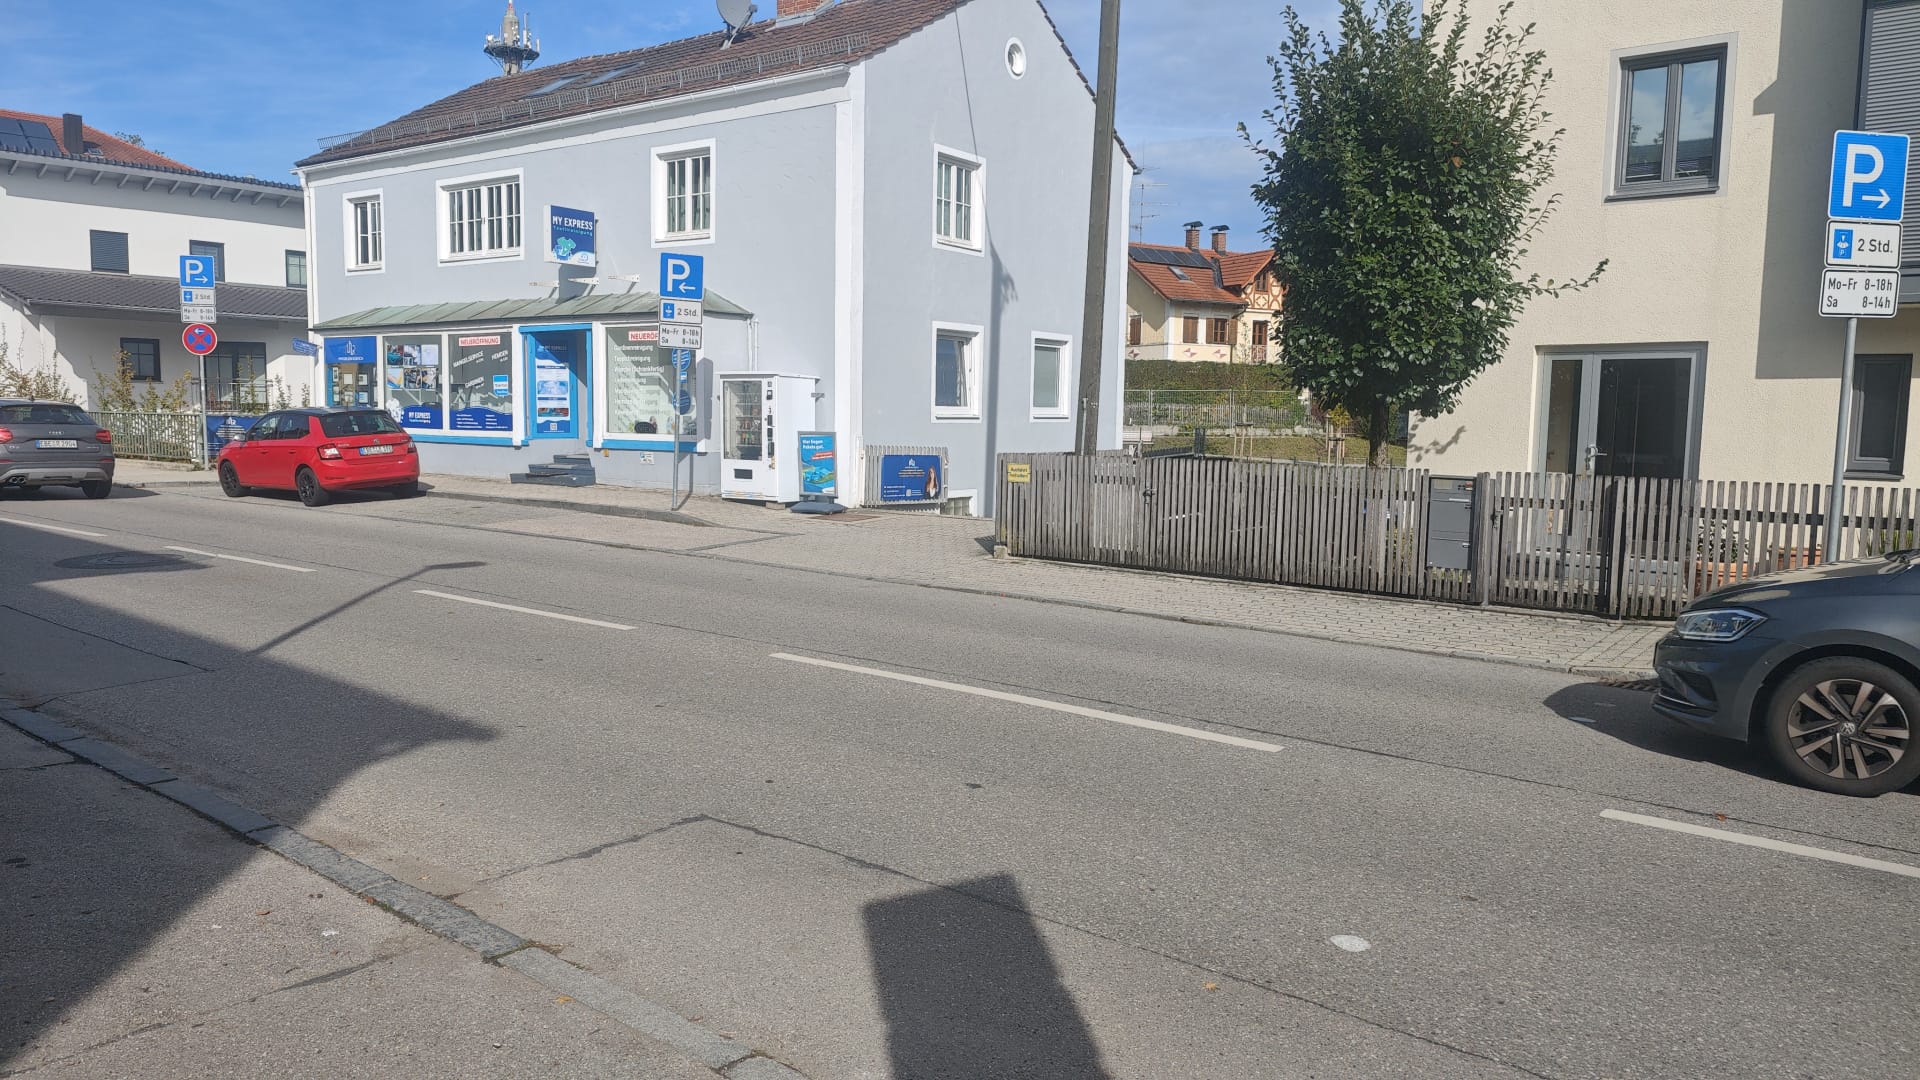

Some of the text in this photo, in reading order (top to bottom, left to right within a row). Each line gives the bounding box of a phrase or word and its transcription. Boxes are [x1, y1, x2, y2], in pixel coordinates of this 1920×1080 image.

[1842, 143, 1884, 207] P
[552, 215, 593, 231] MY EXPRESS
[1857, 238, 1893, 253] 2 Std.
[185, 259, 204, 283] P
[666, 258, 691, 292] P
[1827, 277, 1893, 292] Mo-Fr 8-18h
[1826, 295, 1891, 309] Sa 8-14h
[677, 308, 682, 316] 2
[661, 327, 679, 335] Mo-Fr
[661, 336, 669, 344] Sa
[415, 411, 431, 419] EXPRESS
